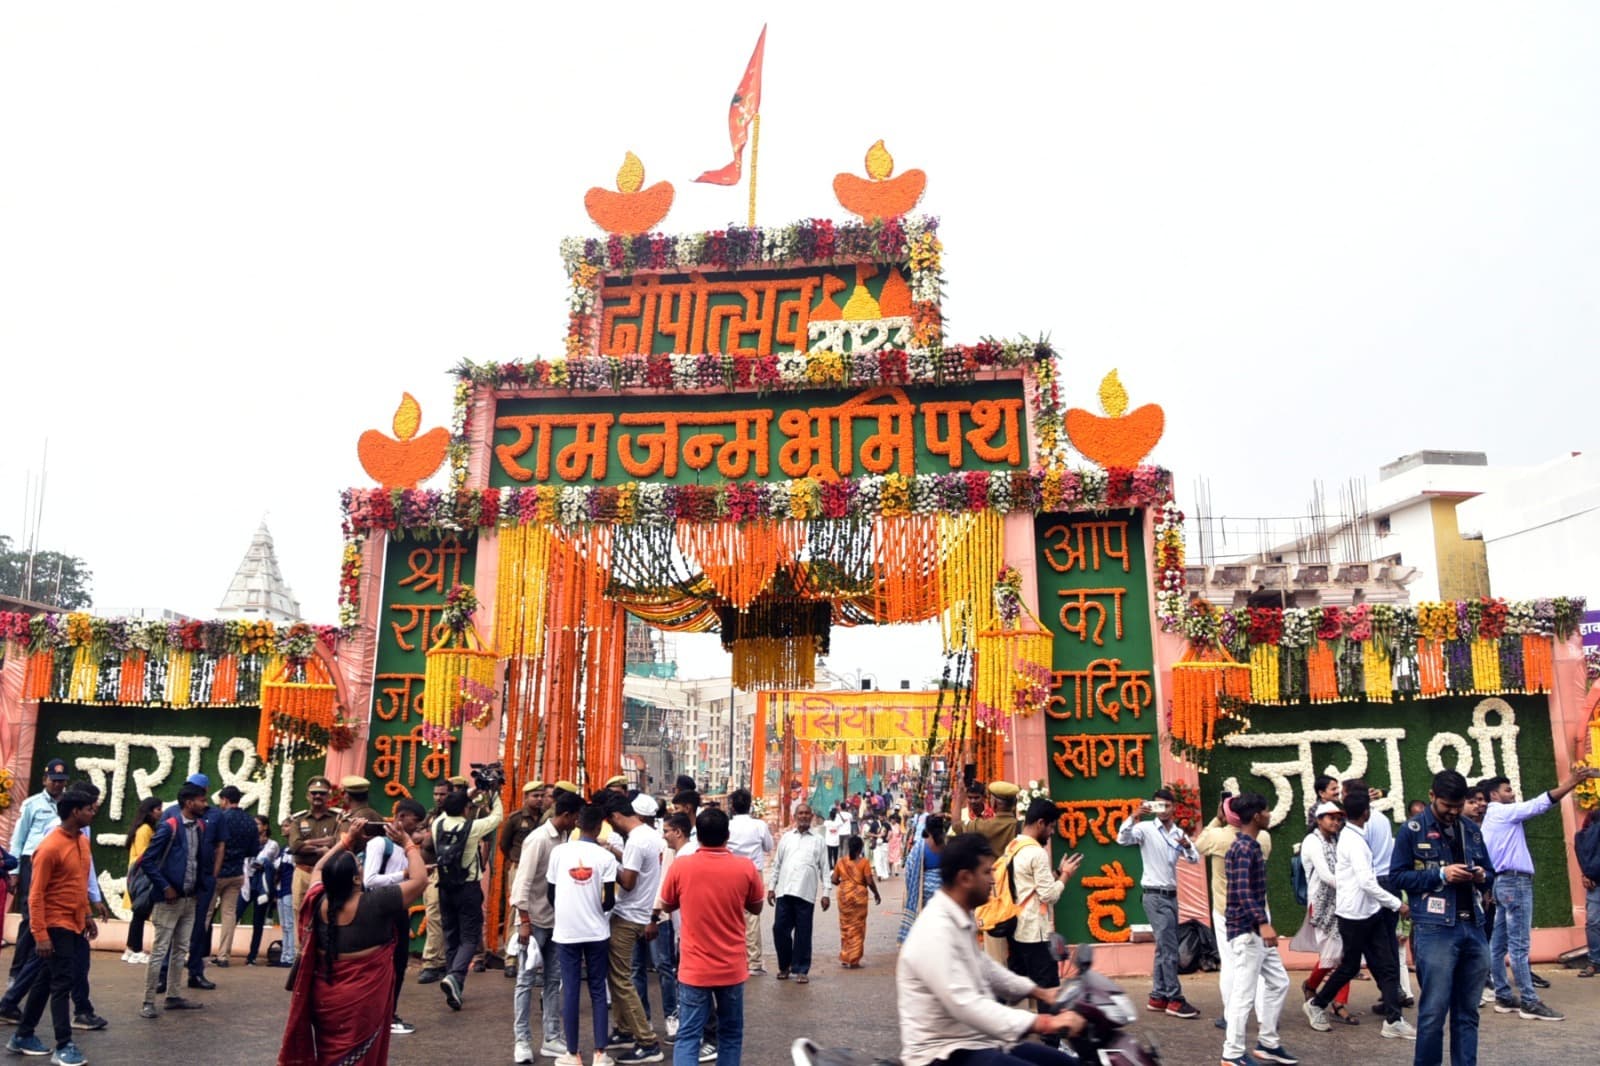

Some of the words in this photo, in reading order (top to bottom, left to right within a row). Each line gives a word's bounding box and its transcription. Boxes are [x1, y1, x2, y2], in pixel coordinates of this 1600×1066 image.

[495, 412, 614, 481] राम
[617, 409, 773, 479] जन्म
[778, 387, 915, 484] भूमि
[921, 399, 1022, 468] पथ
[398, 534, 468, 593] श्री
[1043, 521, 1130, 572] आप
[1057, 587, 1127, 646] का
[1046, 658, 1152, 723] हार्दिक
[56, 730, 211, 820] जय
[372, 724, 456, 800] भूमि
[1053, 733, 1152, 778] स्वागत
[1055, 797, 1143, 849] करत
[1081, 860, 1134, 943] है
